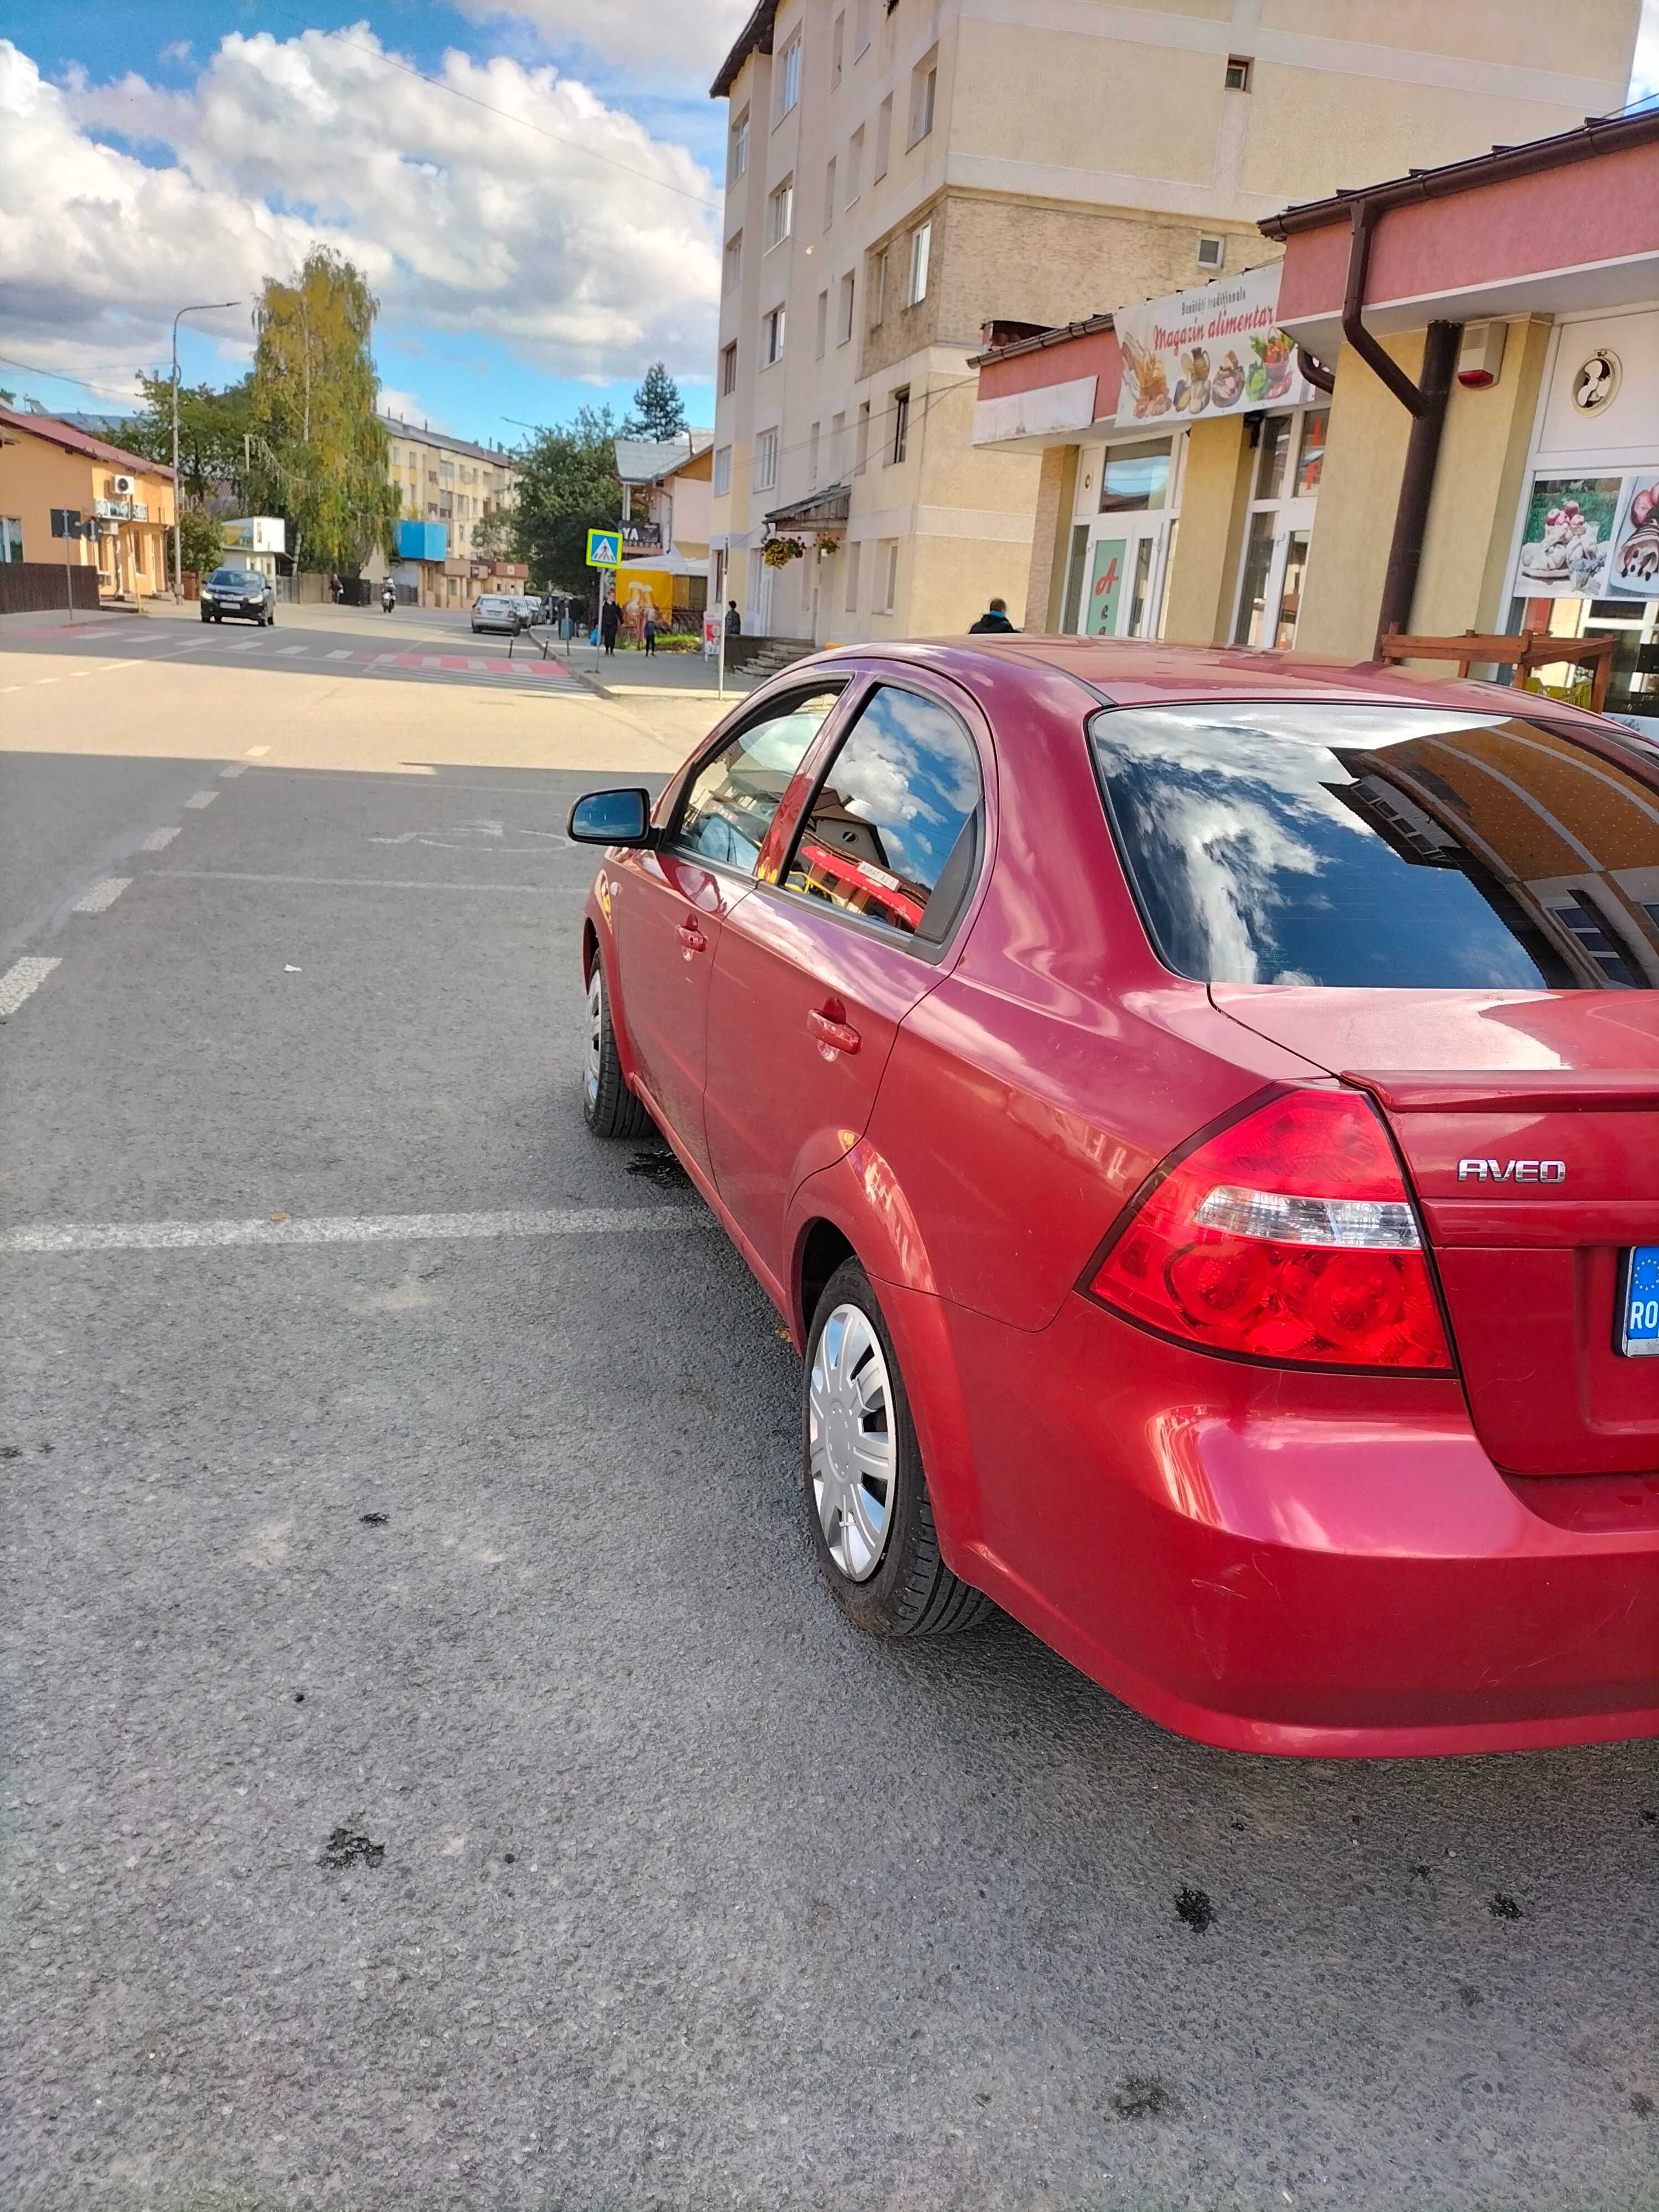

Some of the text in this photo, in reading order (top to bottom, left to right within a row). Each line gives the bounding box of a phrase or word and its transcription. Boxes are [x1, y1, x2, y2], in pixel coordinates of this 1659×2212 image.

[1154, 305, 1274, 356] Magazin alimentar
[1458, 1159, 1566, 1183] AVEO
[1630, 1301, 1658, 1329] RO
